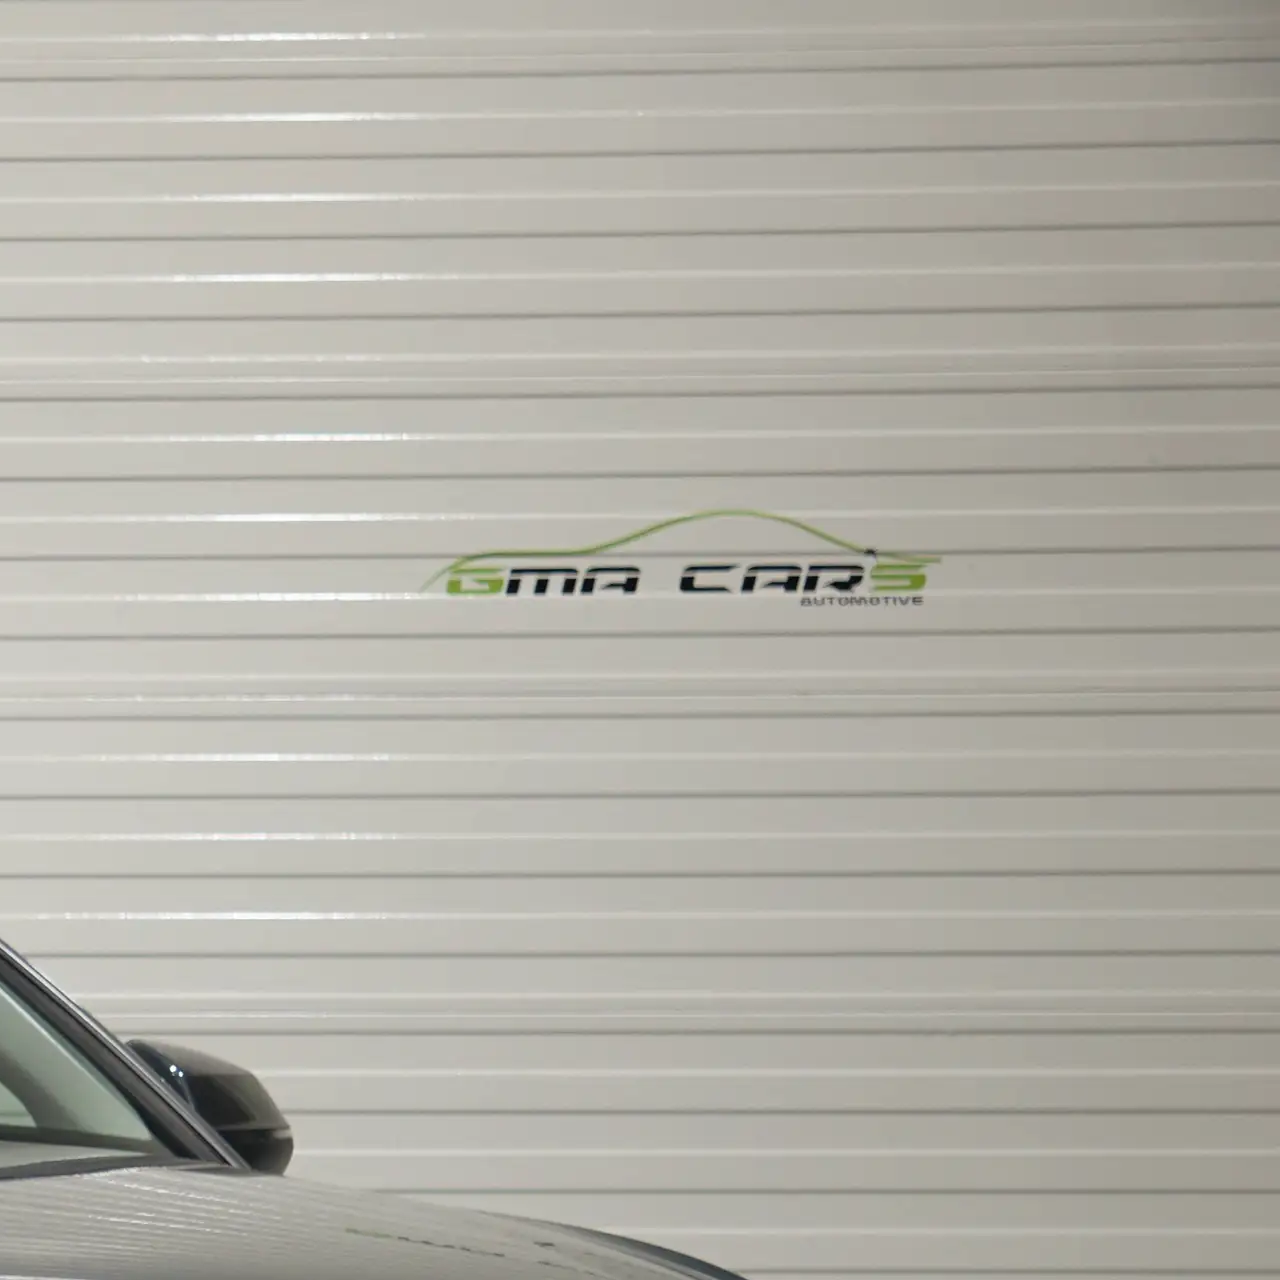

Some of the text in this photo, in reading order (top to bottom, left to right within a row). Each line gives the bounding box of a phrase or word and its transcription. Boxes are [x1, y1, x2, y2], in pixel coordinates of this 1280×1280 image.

[446, 563, 927, 594] GMA CARS
[799, 596, 924, 607] AUTOMOTIVE
